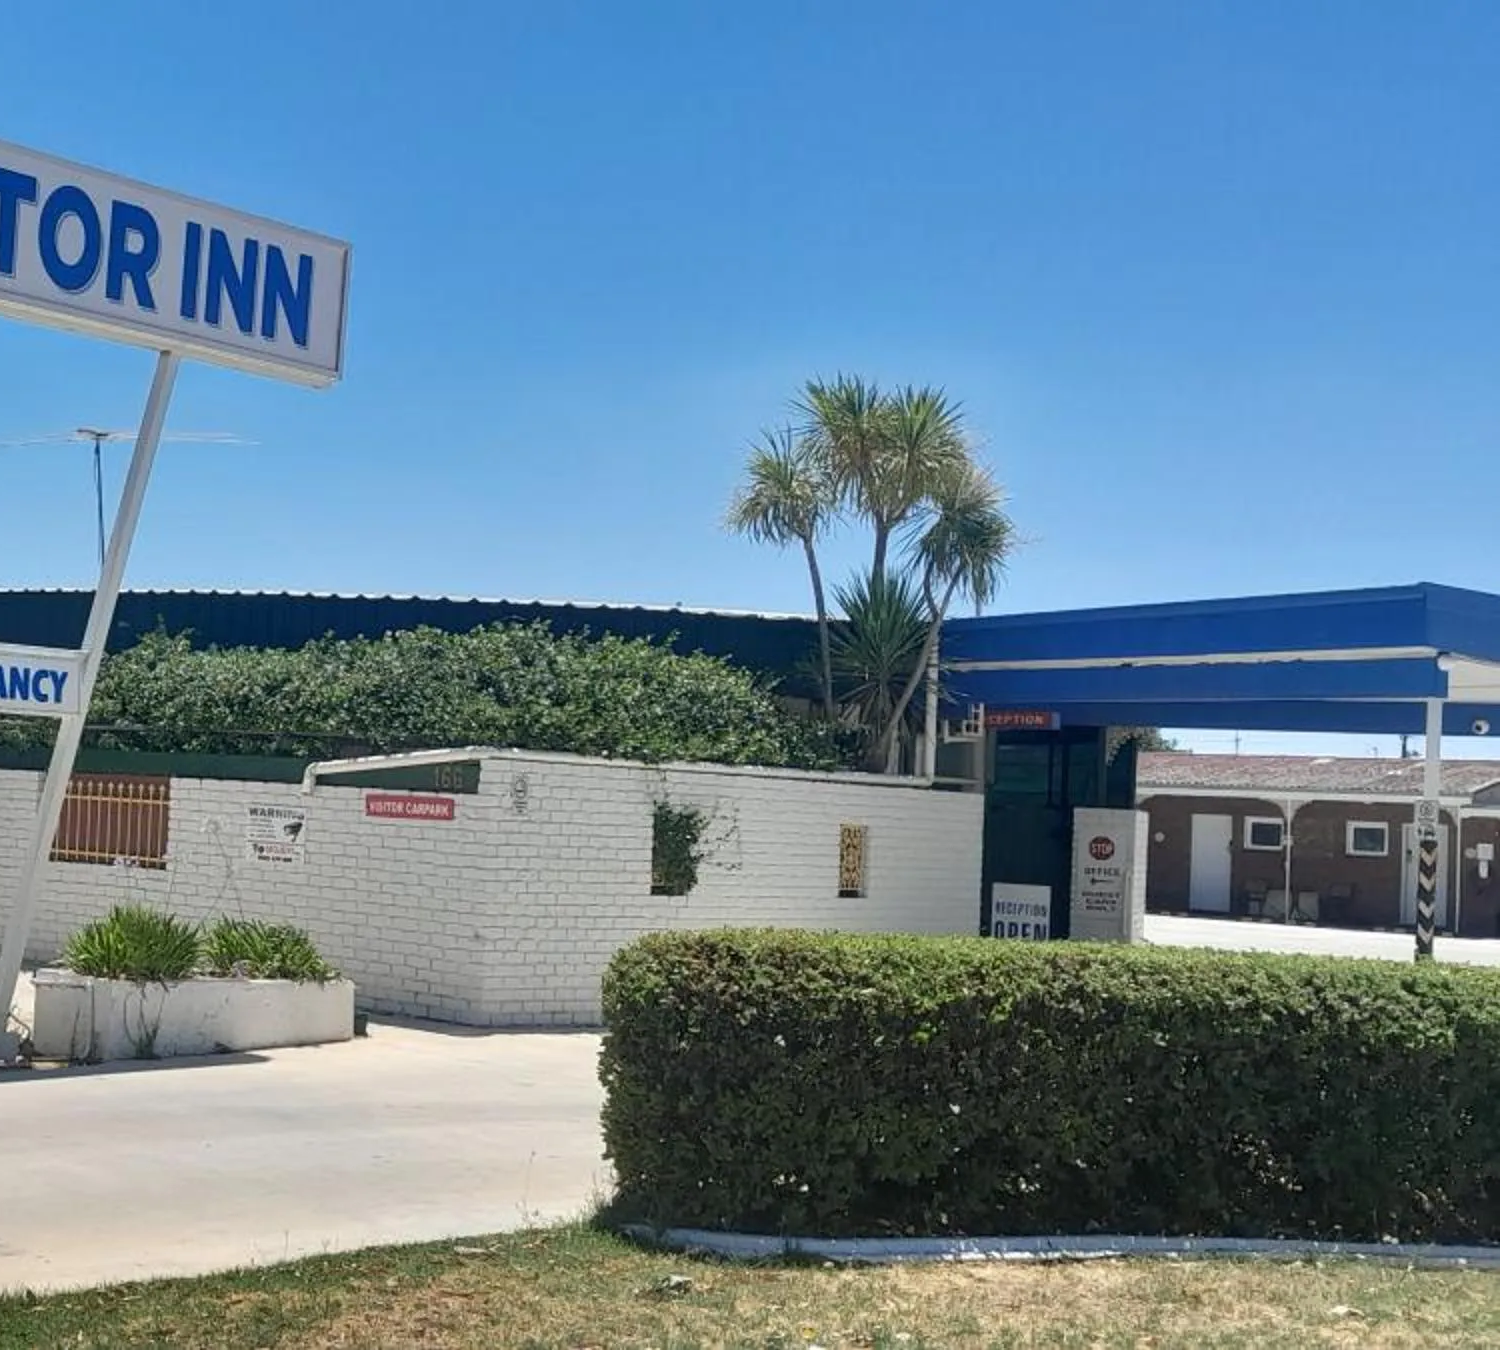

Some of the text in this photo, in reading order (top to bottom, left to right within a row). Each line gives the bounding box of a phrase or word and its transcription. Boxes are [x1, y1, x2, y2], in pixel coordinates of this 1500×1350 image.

[180, 222, 314, 348] INN
[987, 714, 1045, 726] CEPTION
[434, 766, 463, 790] 166
[368, 801, 450, 817] VISITOR CARPARK
[1091, 843, 1114, 857] STOP
[1083, 867, 1120, 877] OFFICE
[996, 901, 1047, 918] RECEPTION
[995, 921, 1047, 940] OPEN
